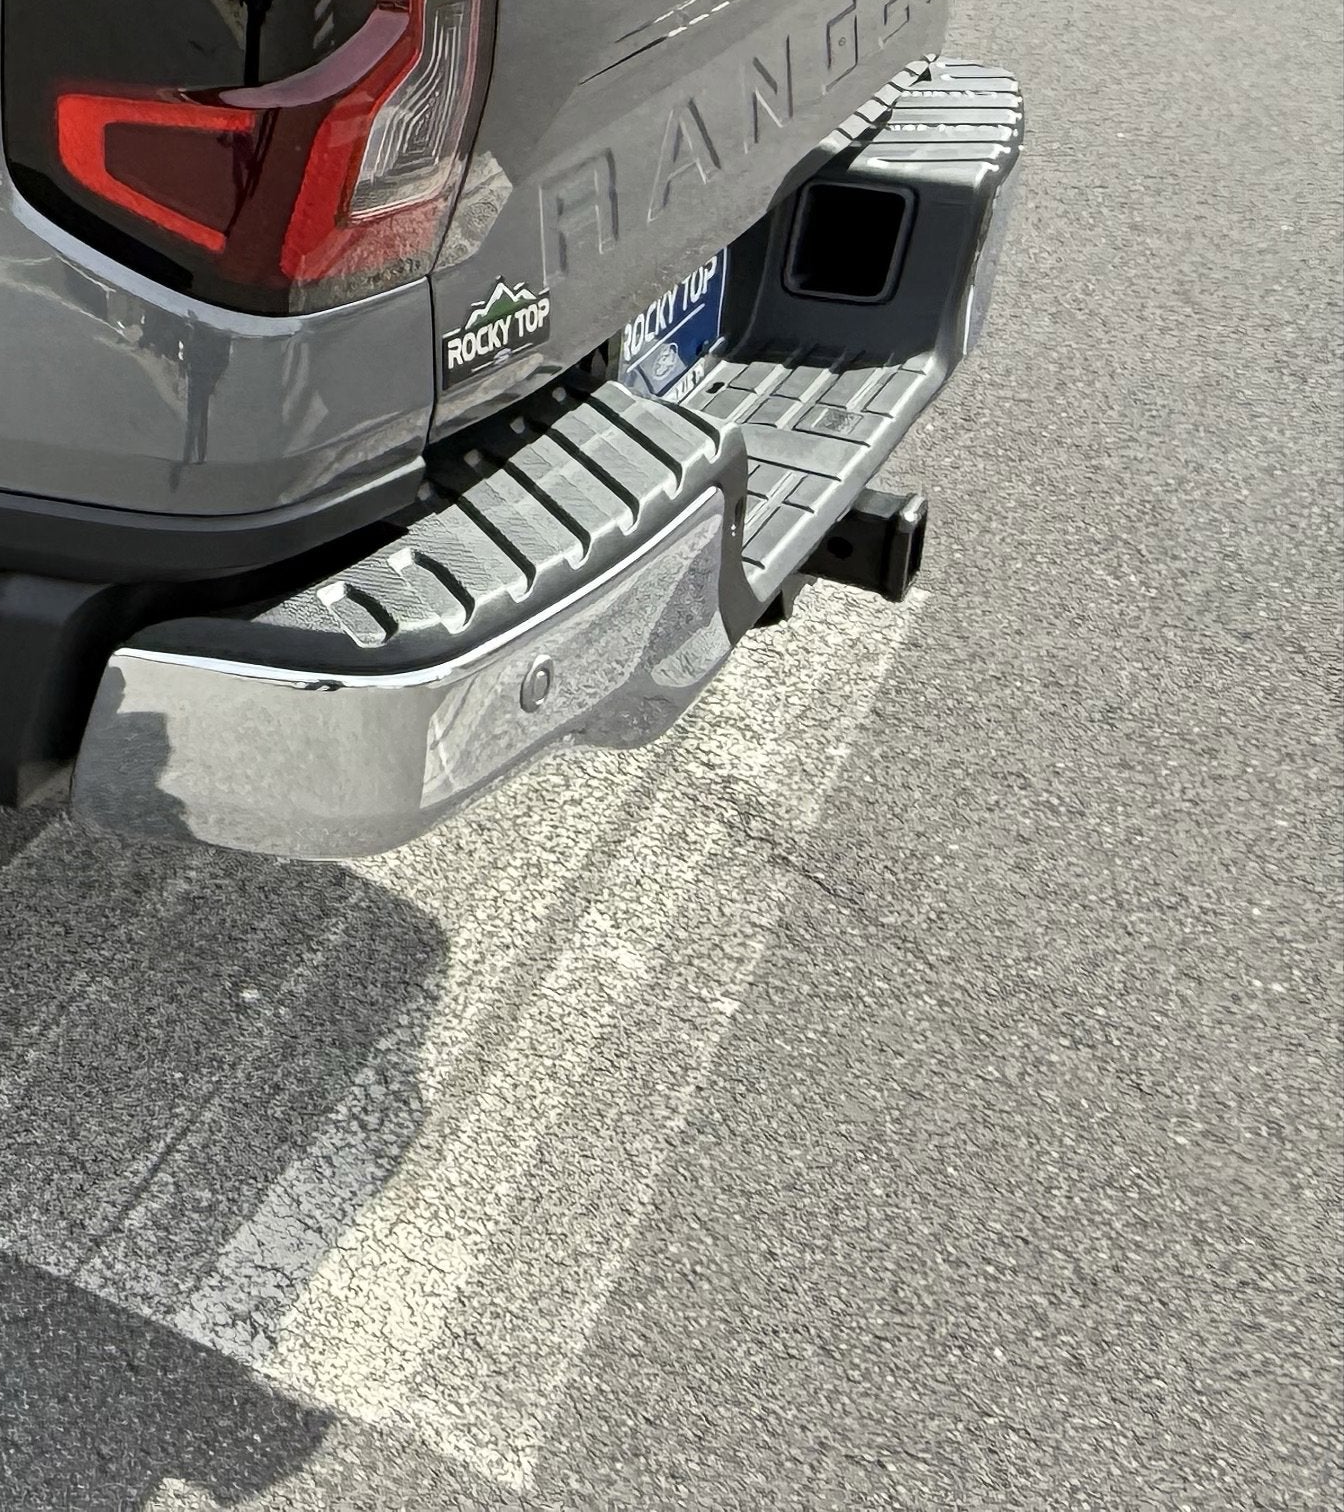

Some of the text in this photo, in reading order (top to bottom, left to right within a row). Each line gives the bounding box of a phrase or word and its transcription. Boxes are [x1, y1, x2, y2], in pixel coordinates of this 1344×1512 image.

[447, 297, 551, 370] ROCKY TOP
[623, 255, 718, 362] ROCKY TOP
